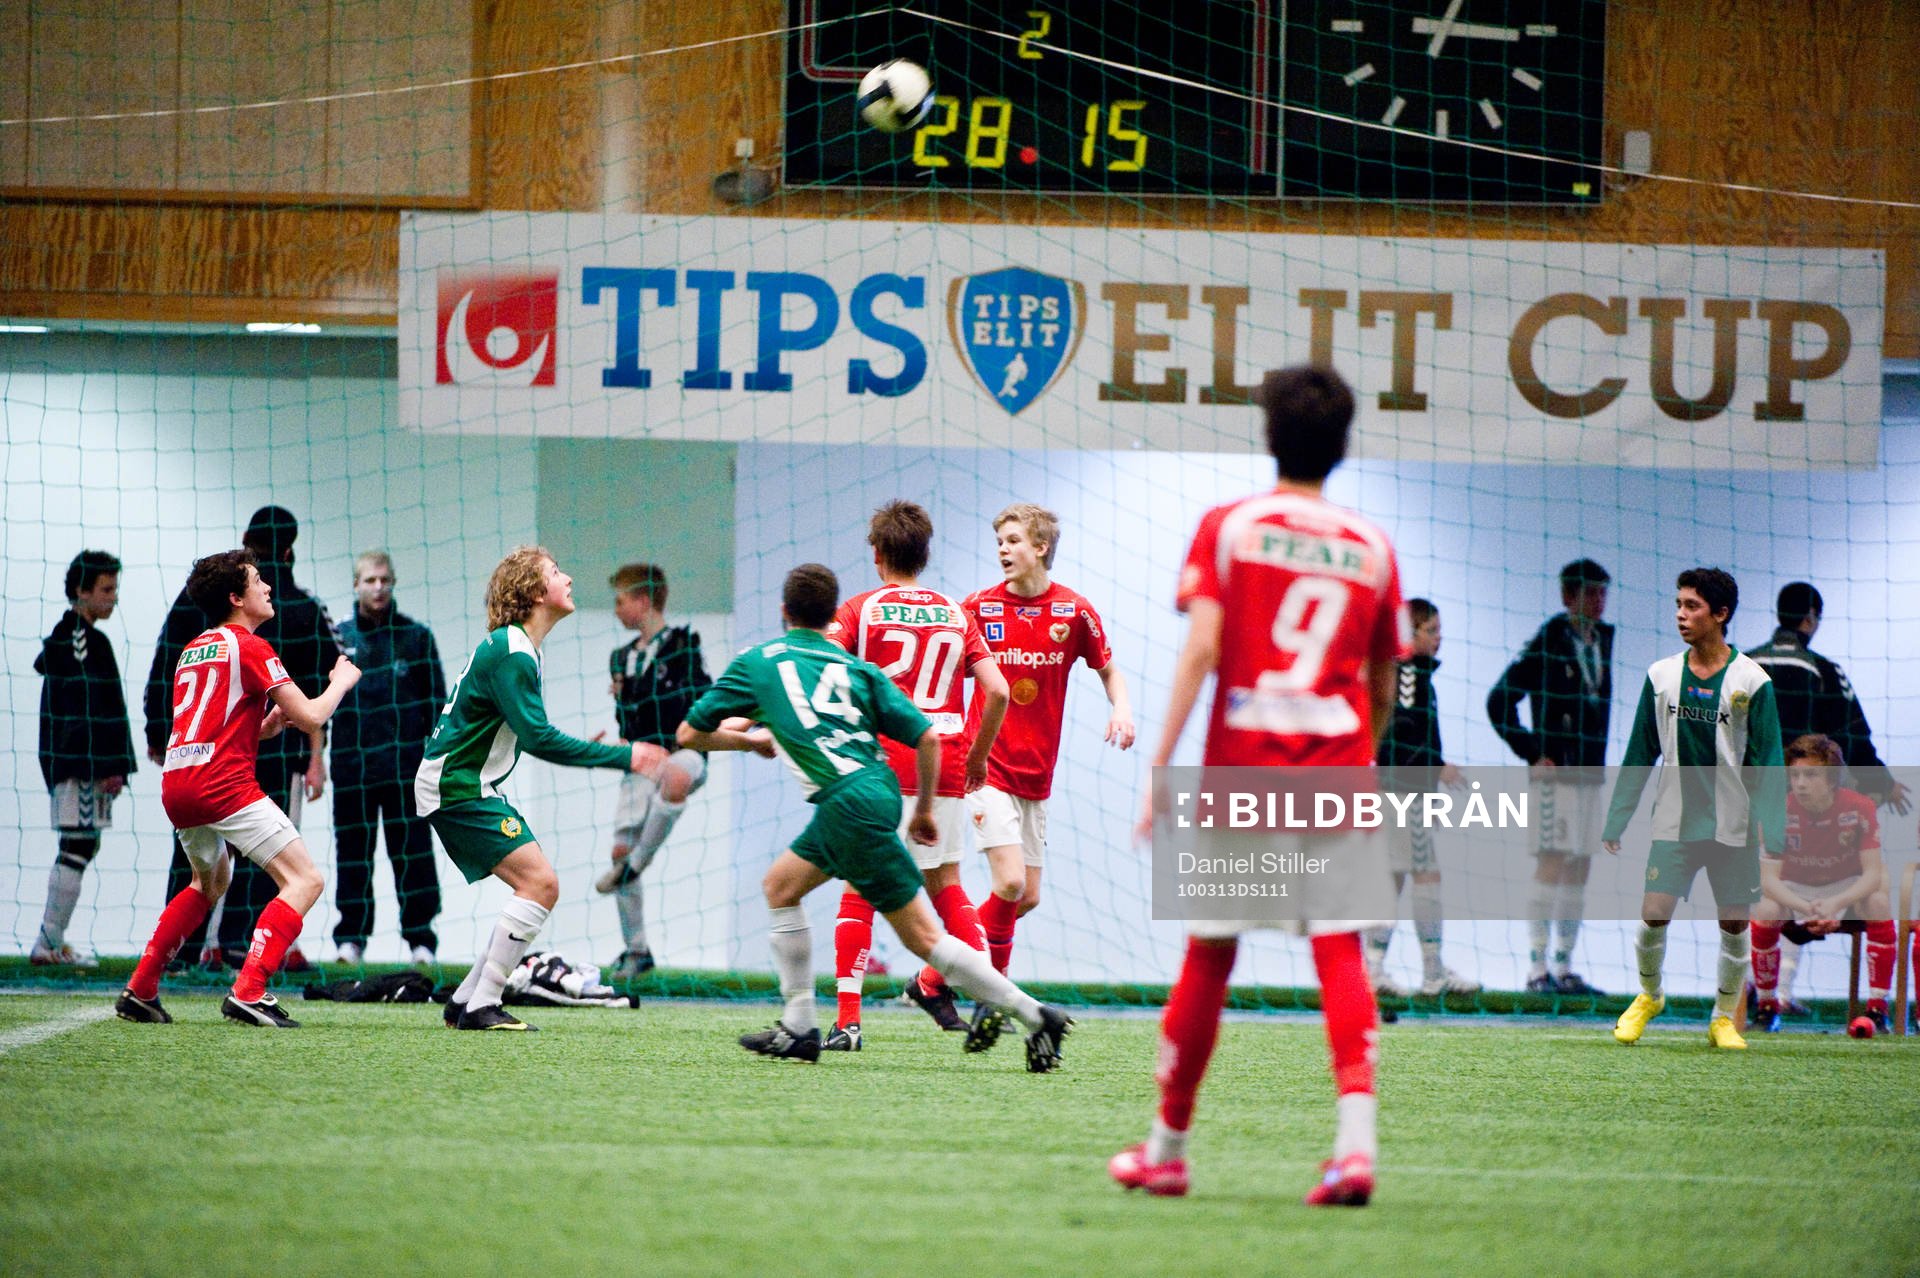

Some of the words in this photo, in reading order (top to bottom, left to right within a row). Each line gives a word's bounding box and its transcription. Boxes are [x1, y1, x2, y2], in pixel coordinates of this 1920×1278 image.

[1018, 11, 1051, 59] 2
[972, 321, 1060, 347] ELIT
[973, 294, 1060, 320] TIPS
[582, 267, 928, 397] TIPS
[1099, 283, 1454, 413] ELIT
[1507, 292, 1852, 422] CUP
[881, 605, 949, 623] PEAB
[1255, 576, 1350, 690] 9
[777, 660, 863, 729] 14
[880, 629, 965, 709] 20
[166, 667, 218, 749] 21
[1668, 702, 1729, 725] FINLUX
